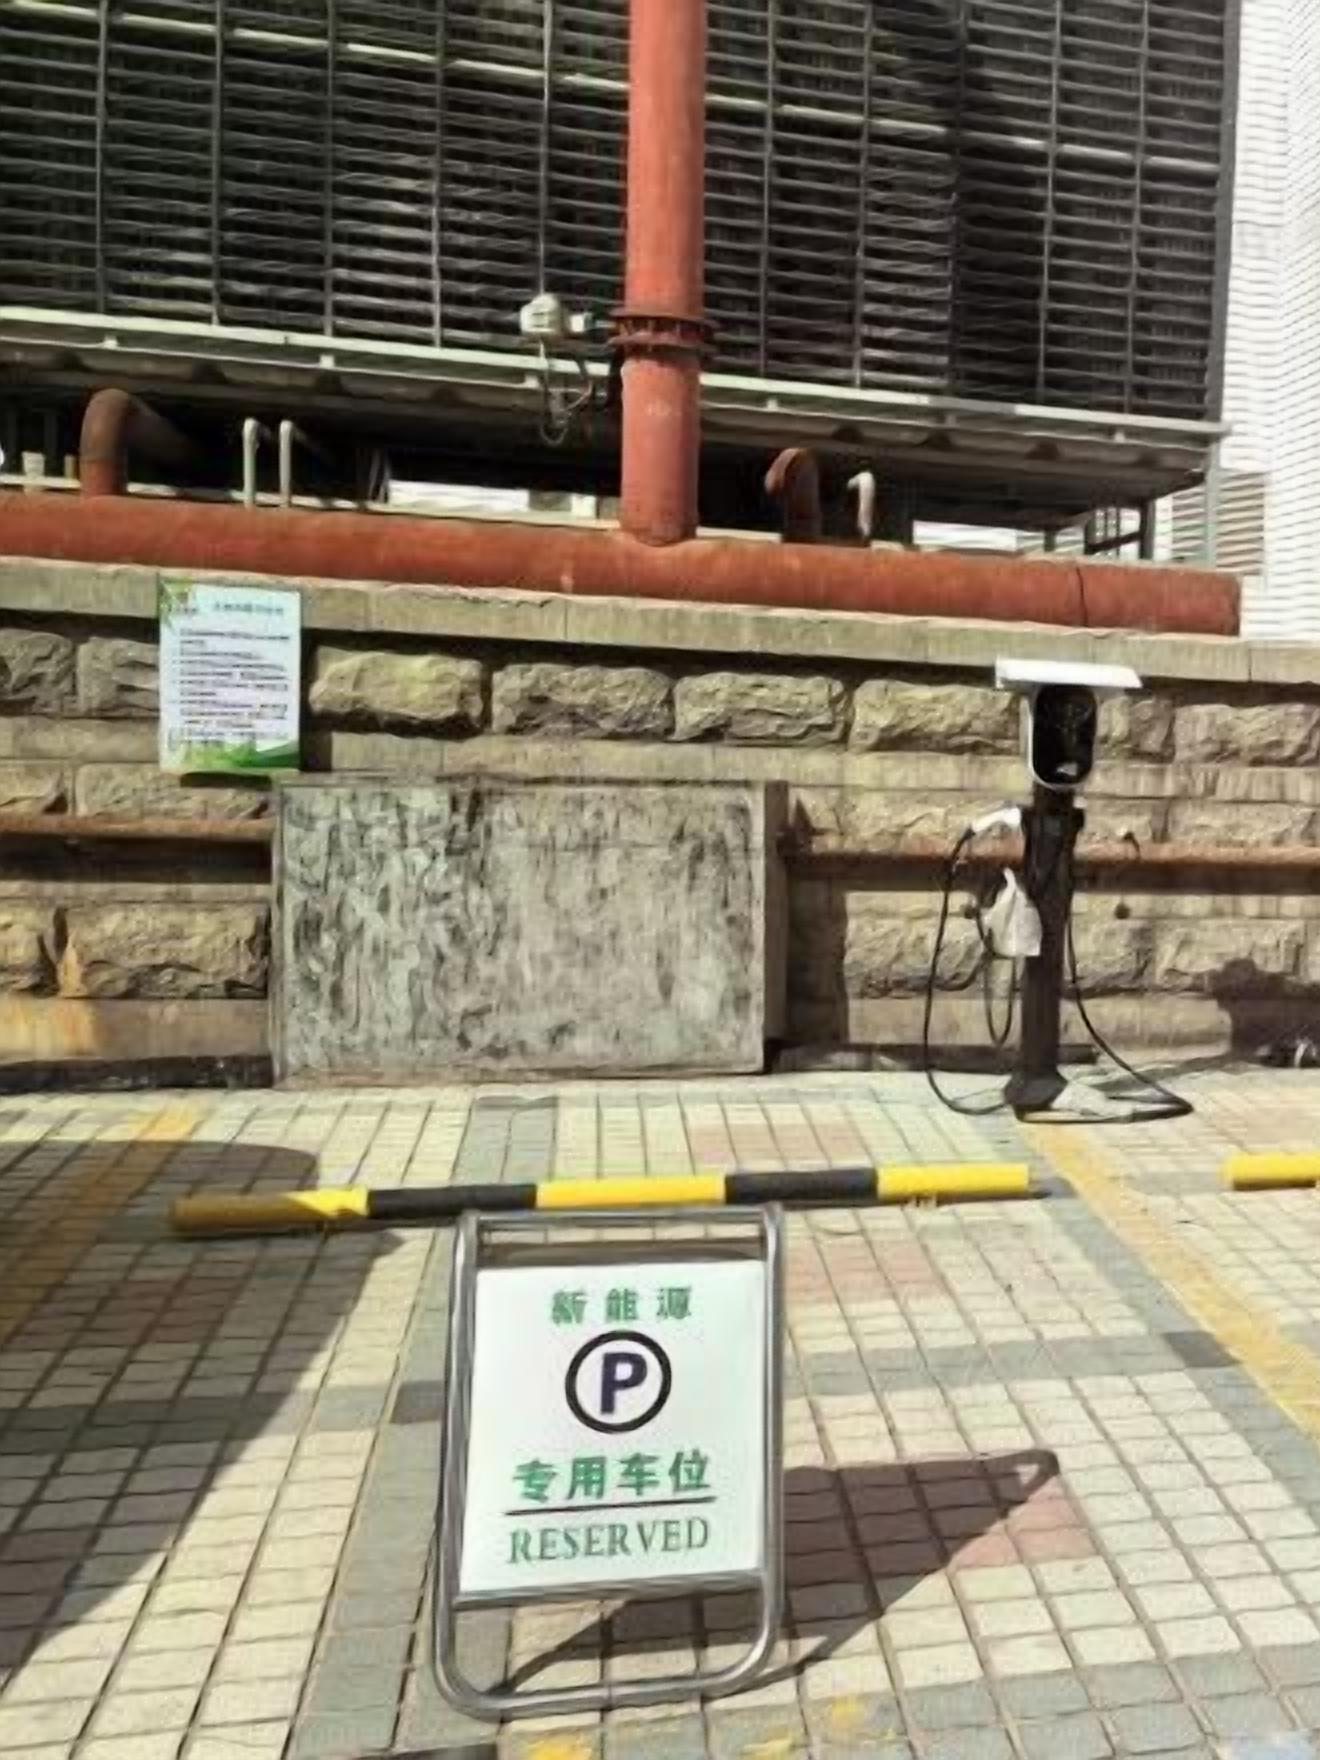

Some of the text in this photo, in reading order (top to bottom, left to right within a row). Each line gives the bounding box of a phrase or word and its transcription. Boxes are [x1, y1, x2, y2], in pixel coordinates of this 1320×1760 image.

[551, 1286, 692, 1324] 新能源
[600, 1352, 649, 1414] P
[512, 1449, 711, 1503] 专用车位
[508, 1516, 708, 1563] RESERVED
